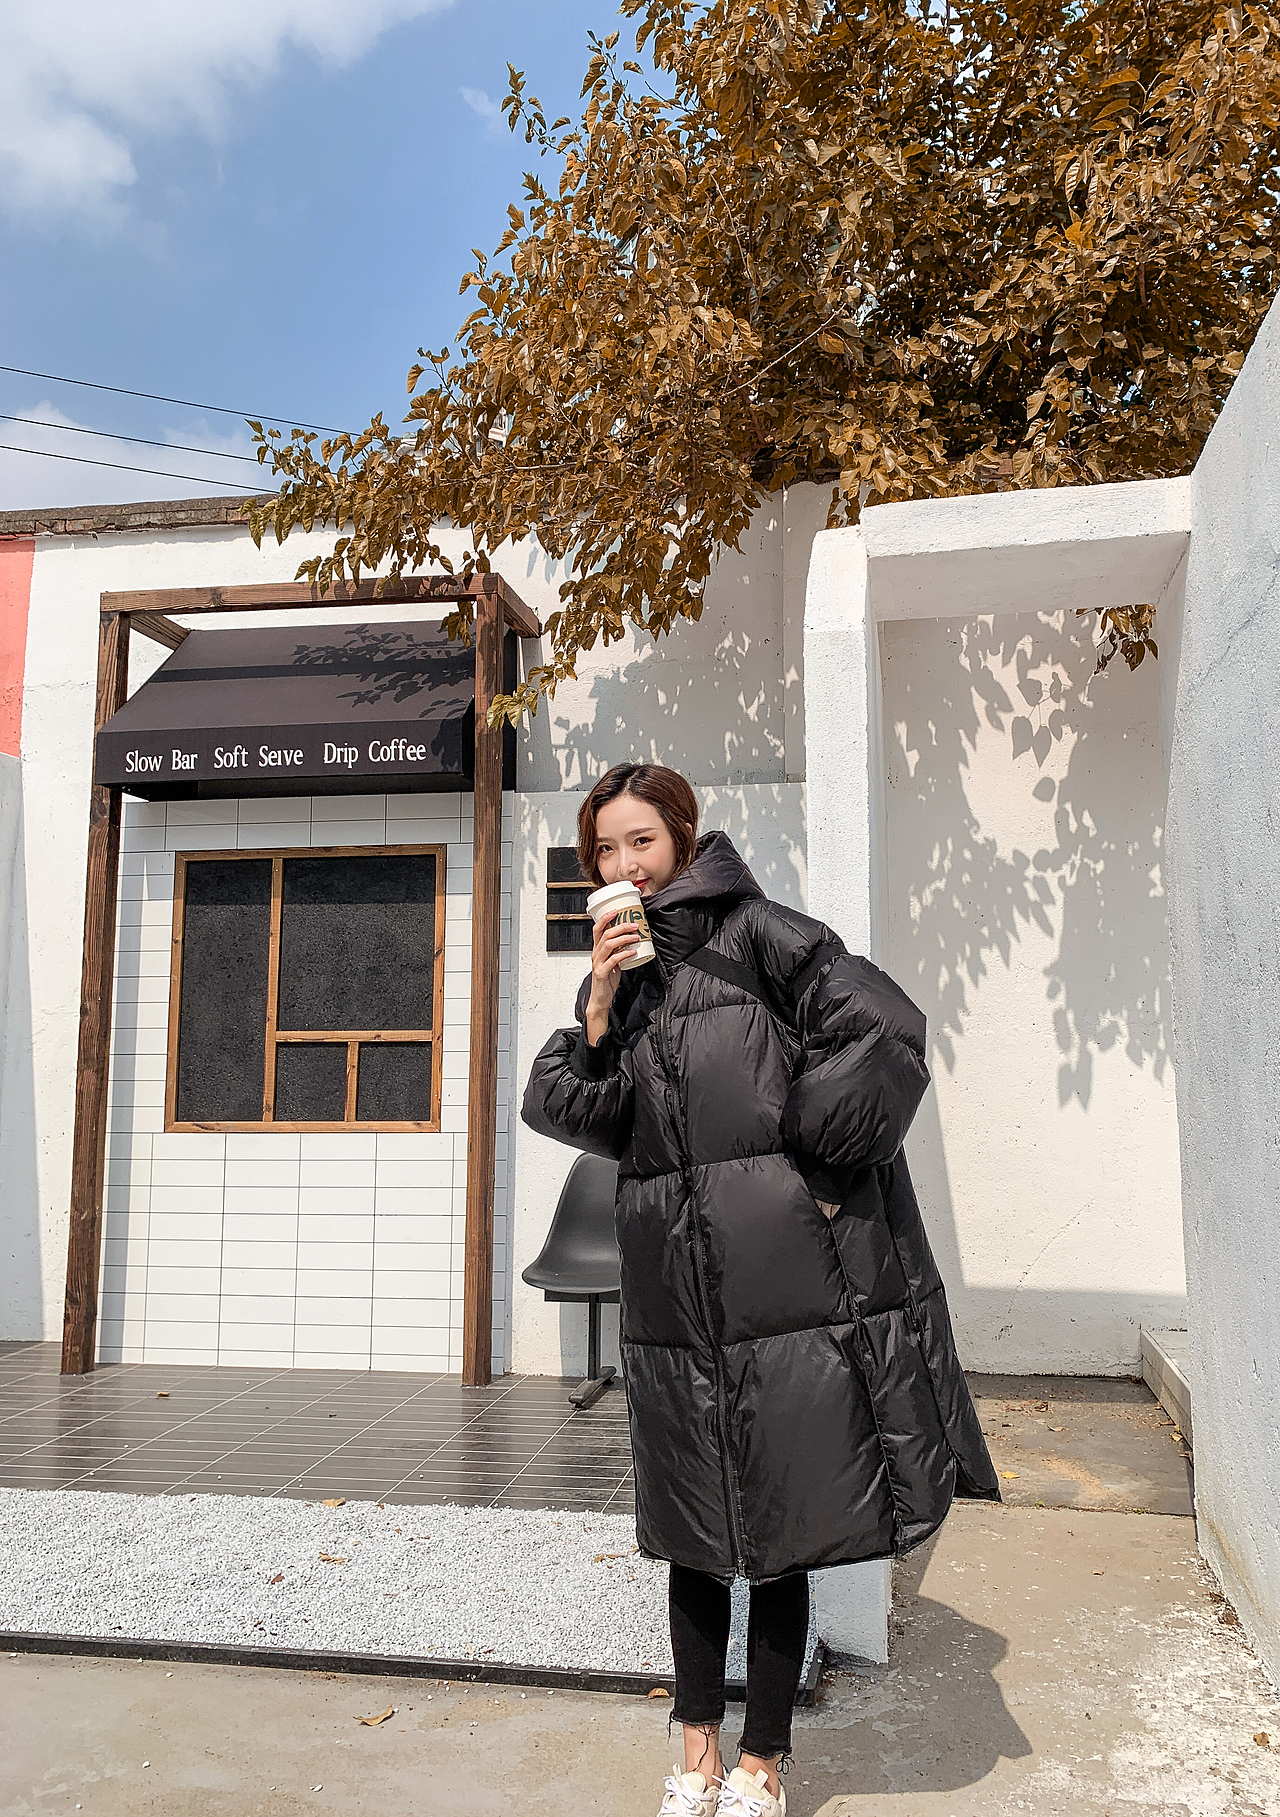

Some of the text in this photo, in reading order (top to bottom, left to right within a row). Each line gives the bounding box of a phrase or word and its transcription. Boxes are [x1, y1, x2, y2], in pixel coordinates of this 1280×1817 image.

[125, 750, 163, 772] Slow
[171, 750, 198, 771] Bar
[213, 744, 249, 769] Soft
[323, 742, 359, 769] Drip
[368, 738, 427, 763] Coffee
